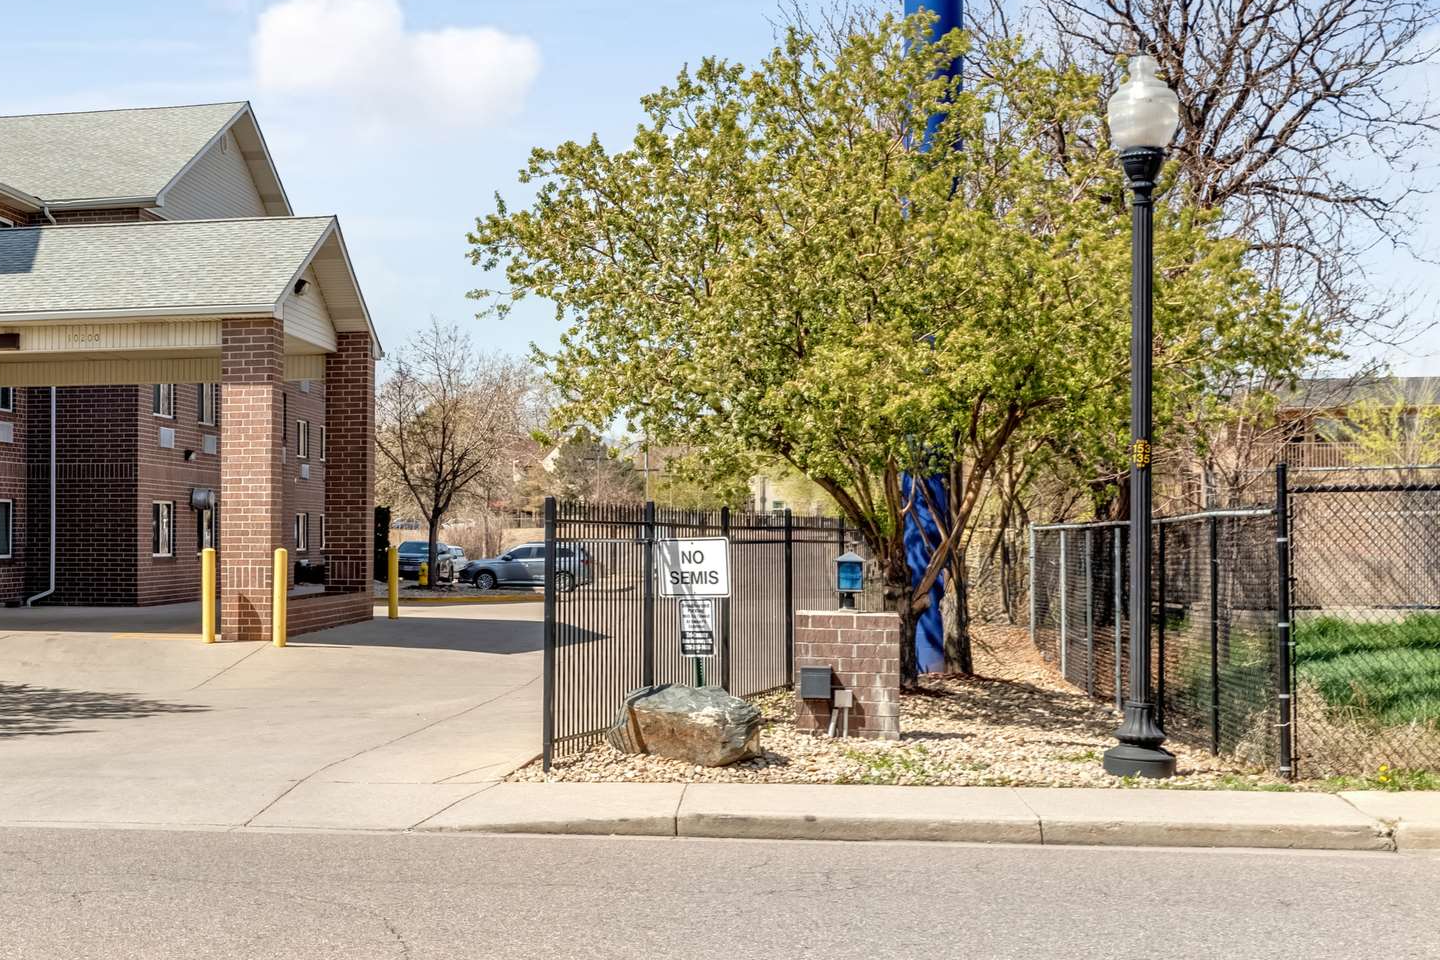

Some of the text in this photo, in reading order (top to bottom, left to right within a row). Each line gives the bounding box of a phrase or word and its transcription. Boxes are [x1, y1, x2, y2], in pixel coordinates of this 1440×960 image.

[1132, 453, 1150, 464] 135
[681, 550, 705, 565] NO
[670, 570, 720, 585] SEMIS
